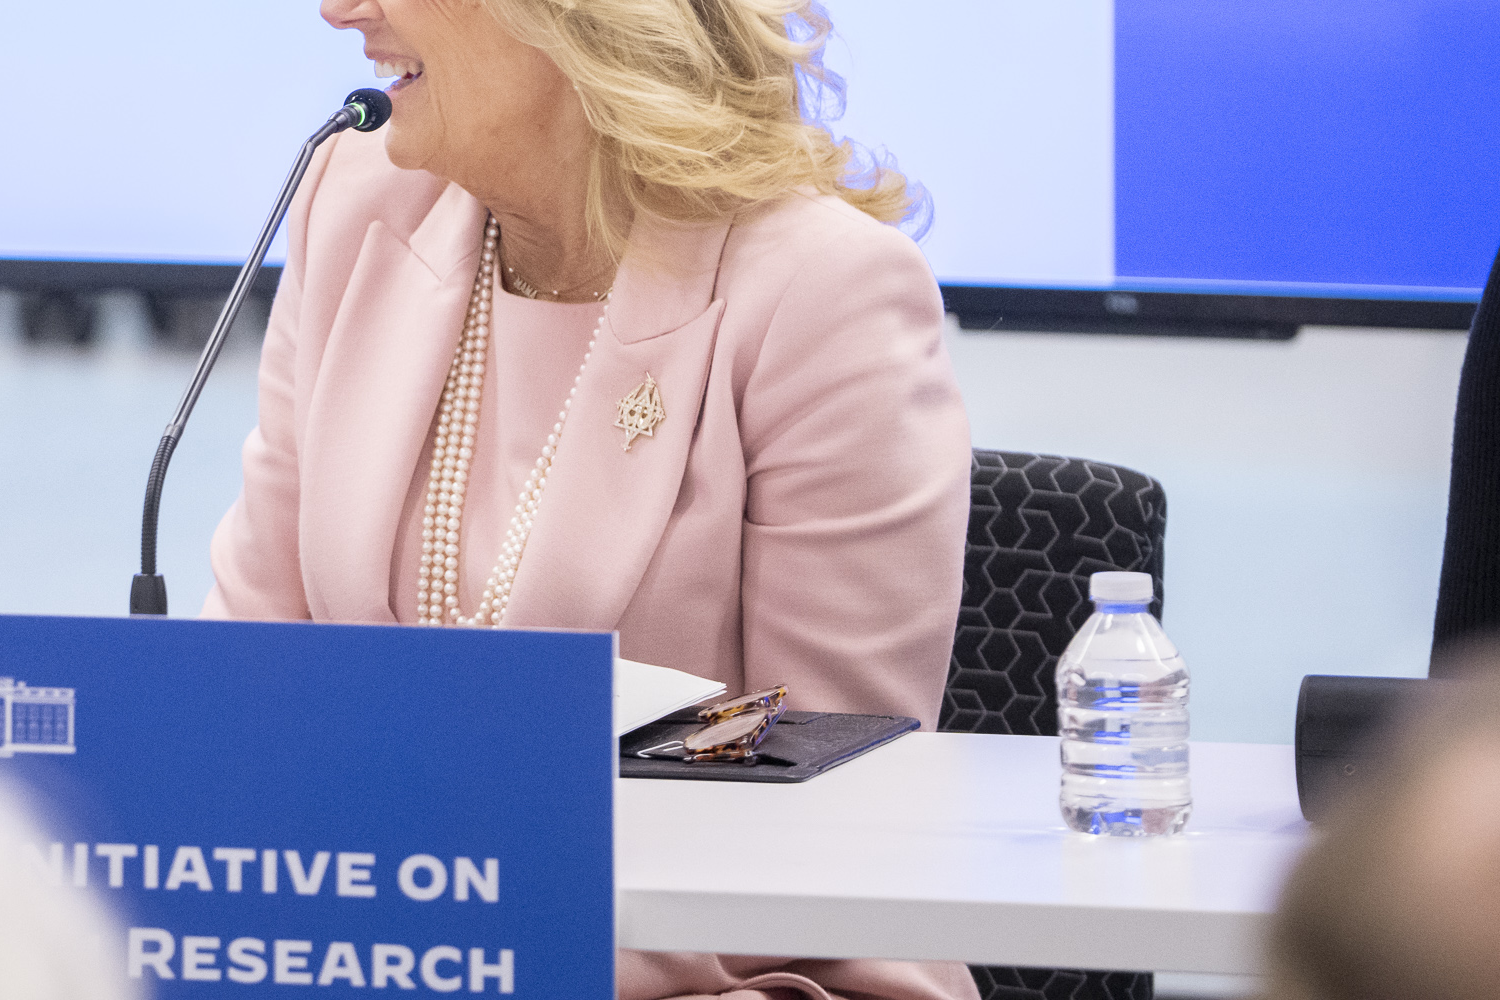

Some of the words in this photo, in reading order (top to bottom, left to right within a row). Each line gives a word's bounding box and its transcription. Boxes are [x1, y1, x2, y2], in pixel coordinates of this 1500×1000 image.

[24, 843, 376, 897] NITIATIVE
[398, 854, 499, 902] ON
[128, 926, 514, 994] RESEARCH
